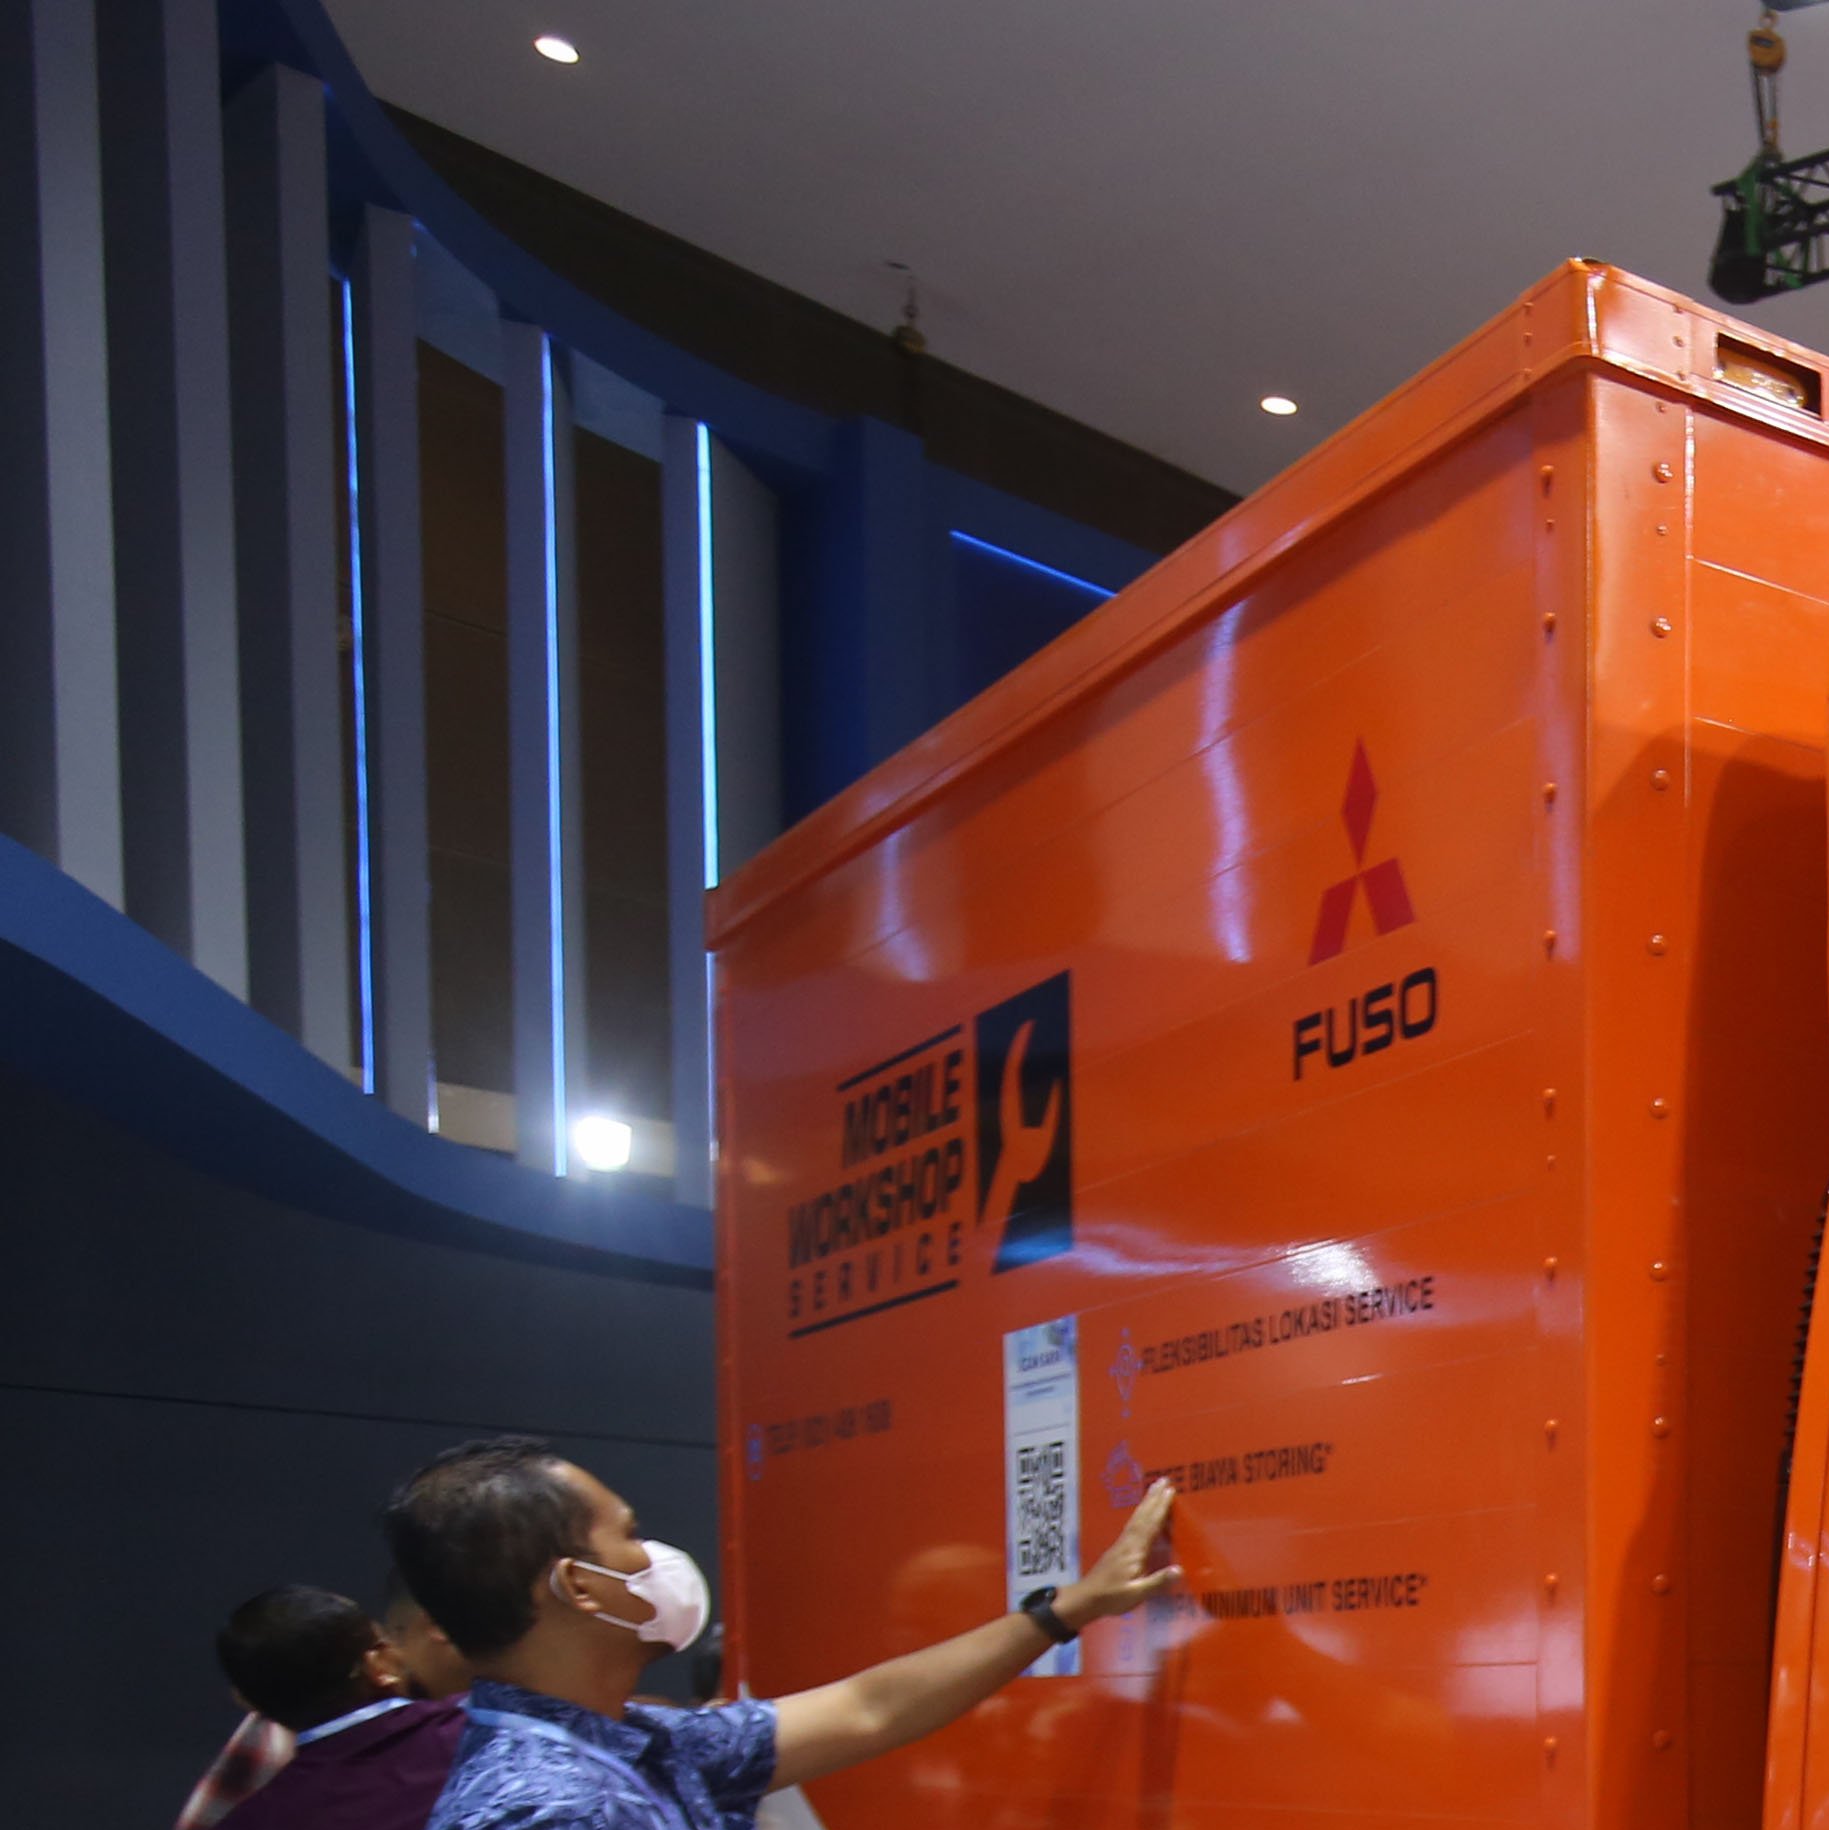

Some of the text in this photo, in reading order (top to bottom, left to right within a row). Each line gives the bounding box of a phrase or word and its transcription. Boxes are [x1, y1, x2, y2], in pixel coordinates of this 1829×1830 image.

[1293, 965, 1438, 1081] FUSO
[842, 1049, 962, 1169] MOBILE
[789, 1137, 963, 1269] WORKSHOP
[790, 1221, 961, 1318] SERVICE
[1142, 1276, 1435, 1373] FLEKSIBILITAS LOKASI SERVICE
[1190, 1457, 1237, 1491] BIAYA
[1281, 1581, 1326, 1613] UNIT
